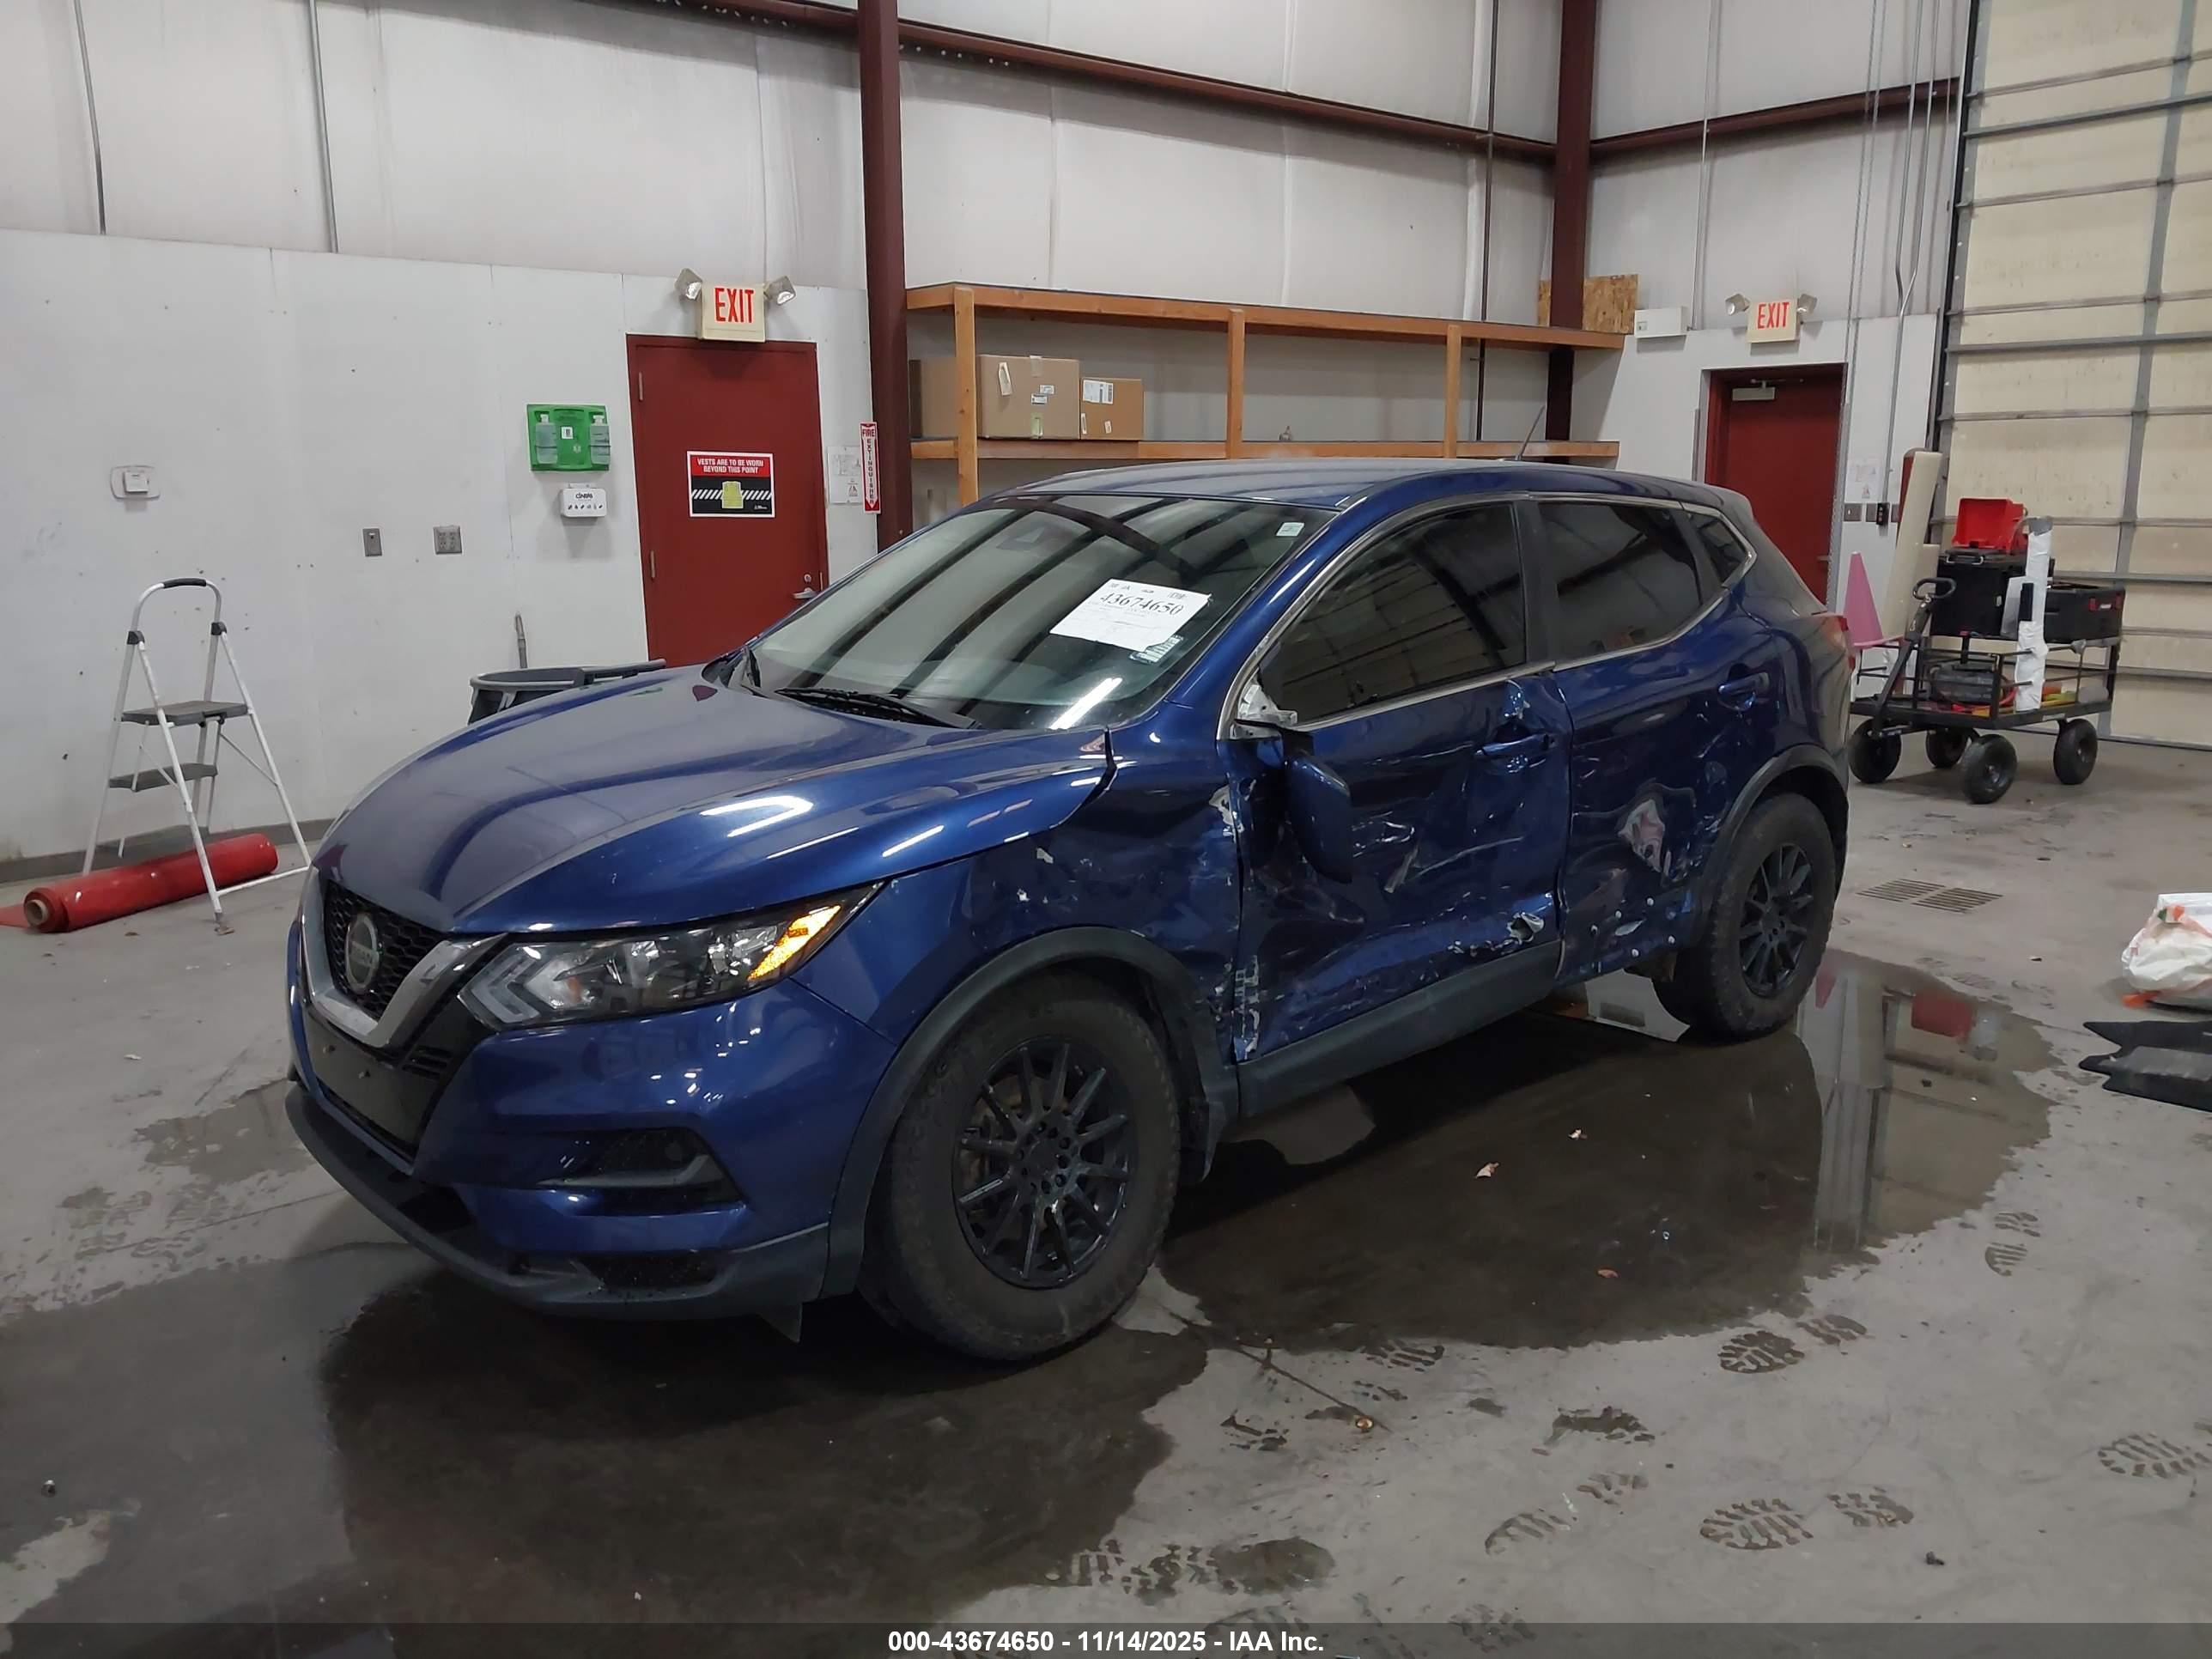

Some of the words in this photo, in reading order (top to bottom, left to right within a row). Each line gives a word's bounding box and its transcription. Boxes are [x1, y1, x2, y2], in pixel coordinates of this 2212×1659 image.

[714, 288, 755, 323] EXIT
[1757, 301, 1790, 329] EXIT
[862, 428, 875, 437] FIRE
